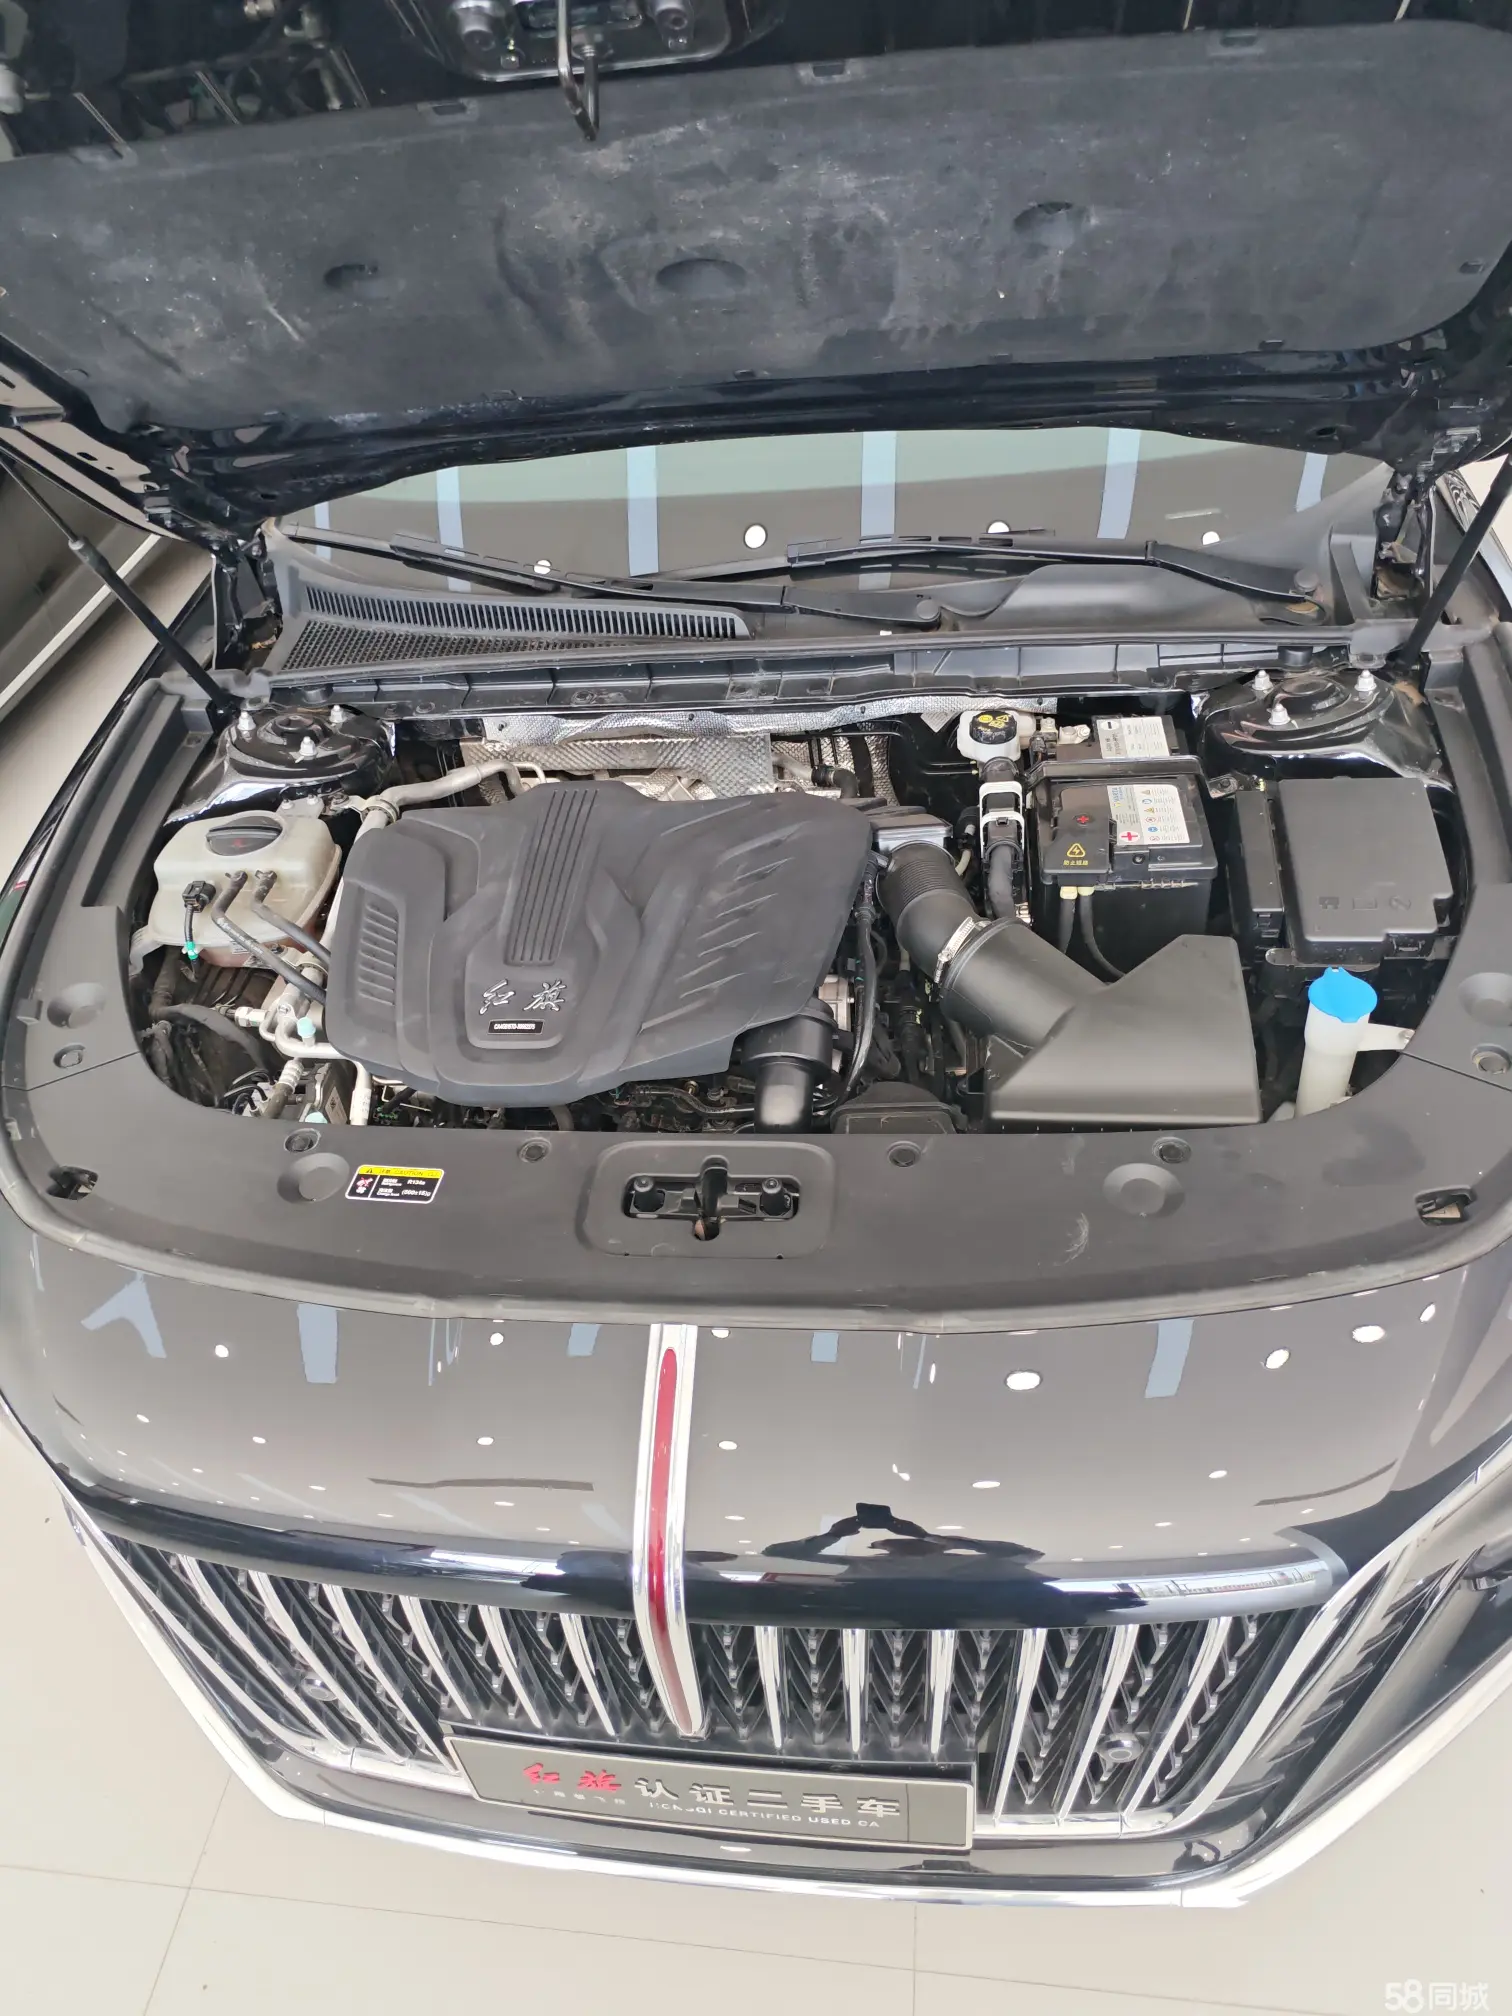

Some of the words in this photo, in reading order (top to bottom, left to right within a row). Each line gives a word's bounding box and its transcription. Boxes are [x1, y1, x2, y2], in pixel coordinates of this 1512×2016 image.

[479, 979, 567, 1014] 红旗
[718, 1808, 802, 1822] CERTIFIED
[808, 1816, 851, 1826] USED
